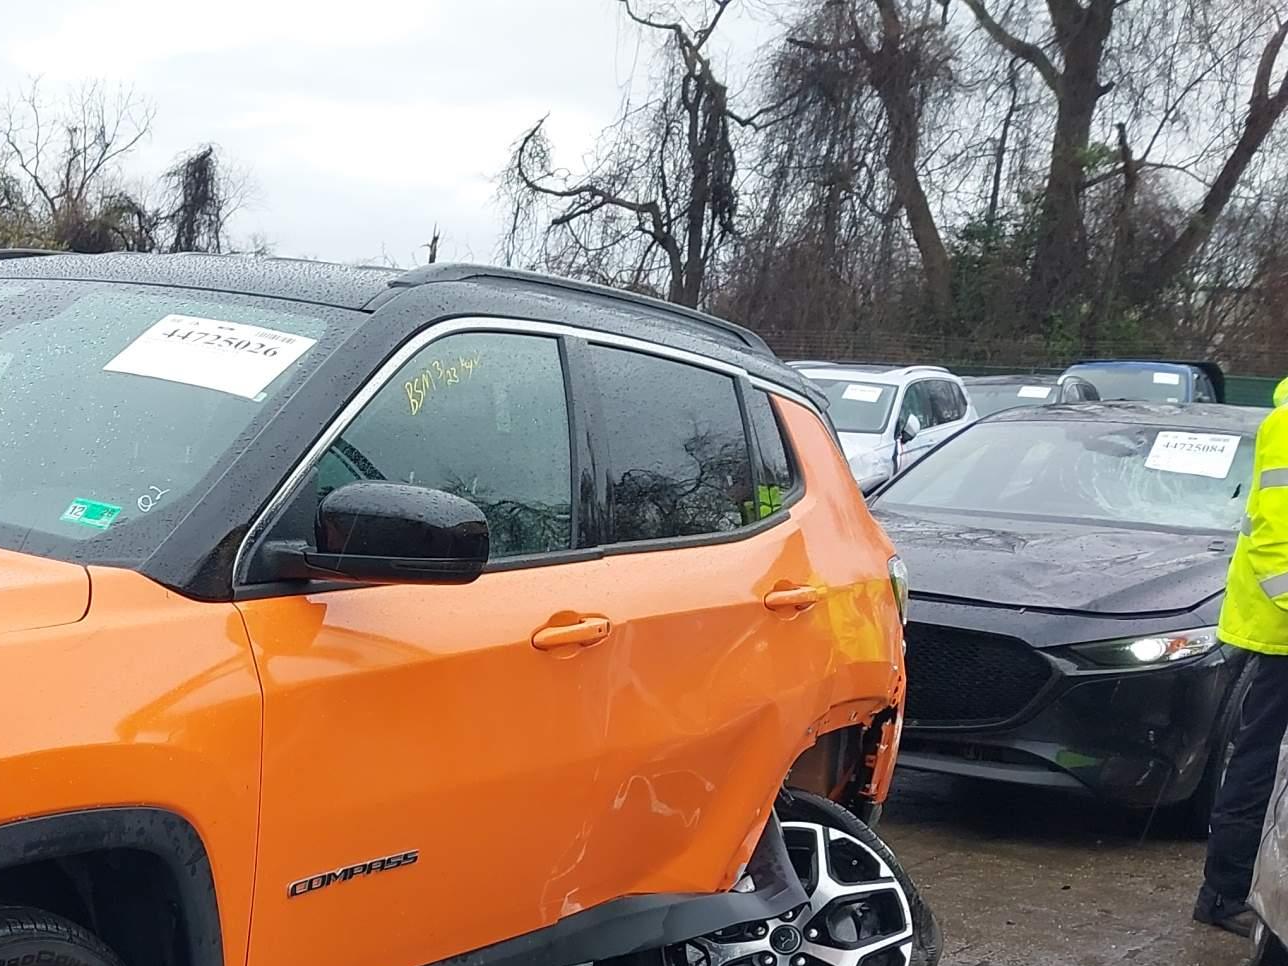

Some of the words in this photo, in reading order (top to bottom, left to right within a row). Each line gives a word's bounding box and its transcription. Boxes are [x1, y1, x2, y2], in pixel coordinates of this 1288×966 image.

[162, 328, 281, 358] 44725026
[1162, 441, 1225, 453] 44725084
[69, 505, 86, 517] 12
[287, 848, 419, 898] COMPASS
